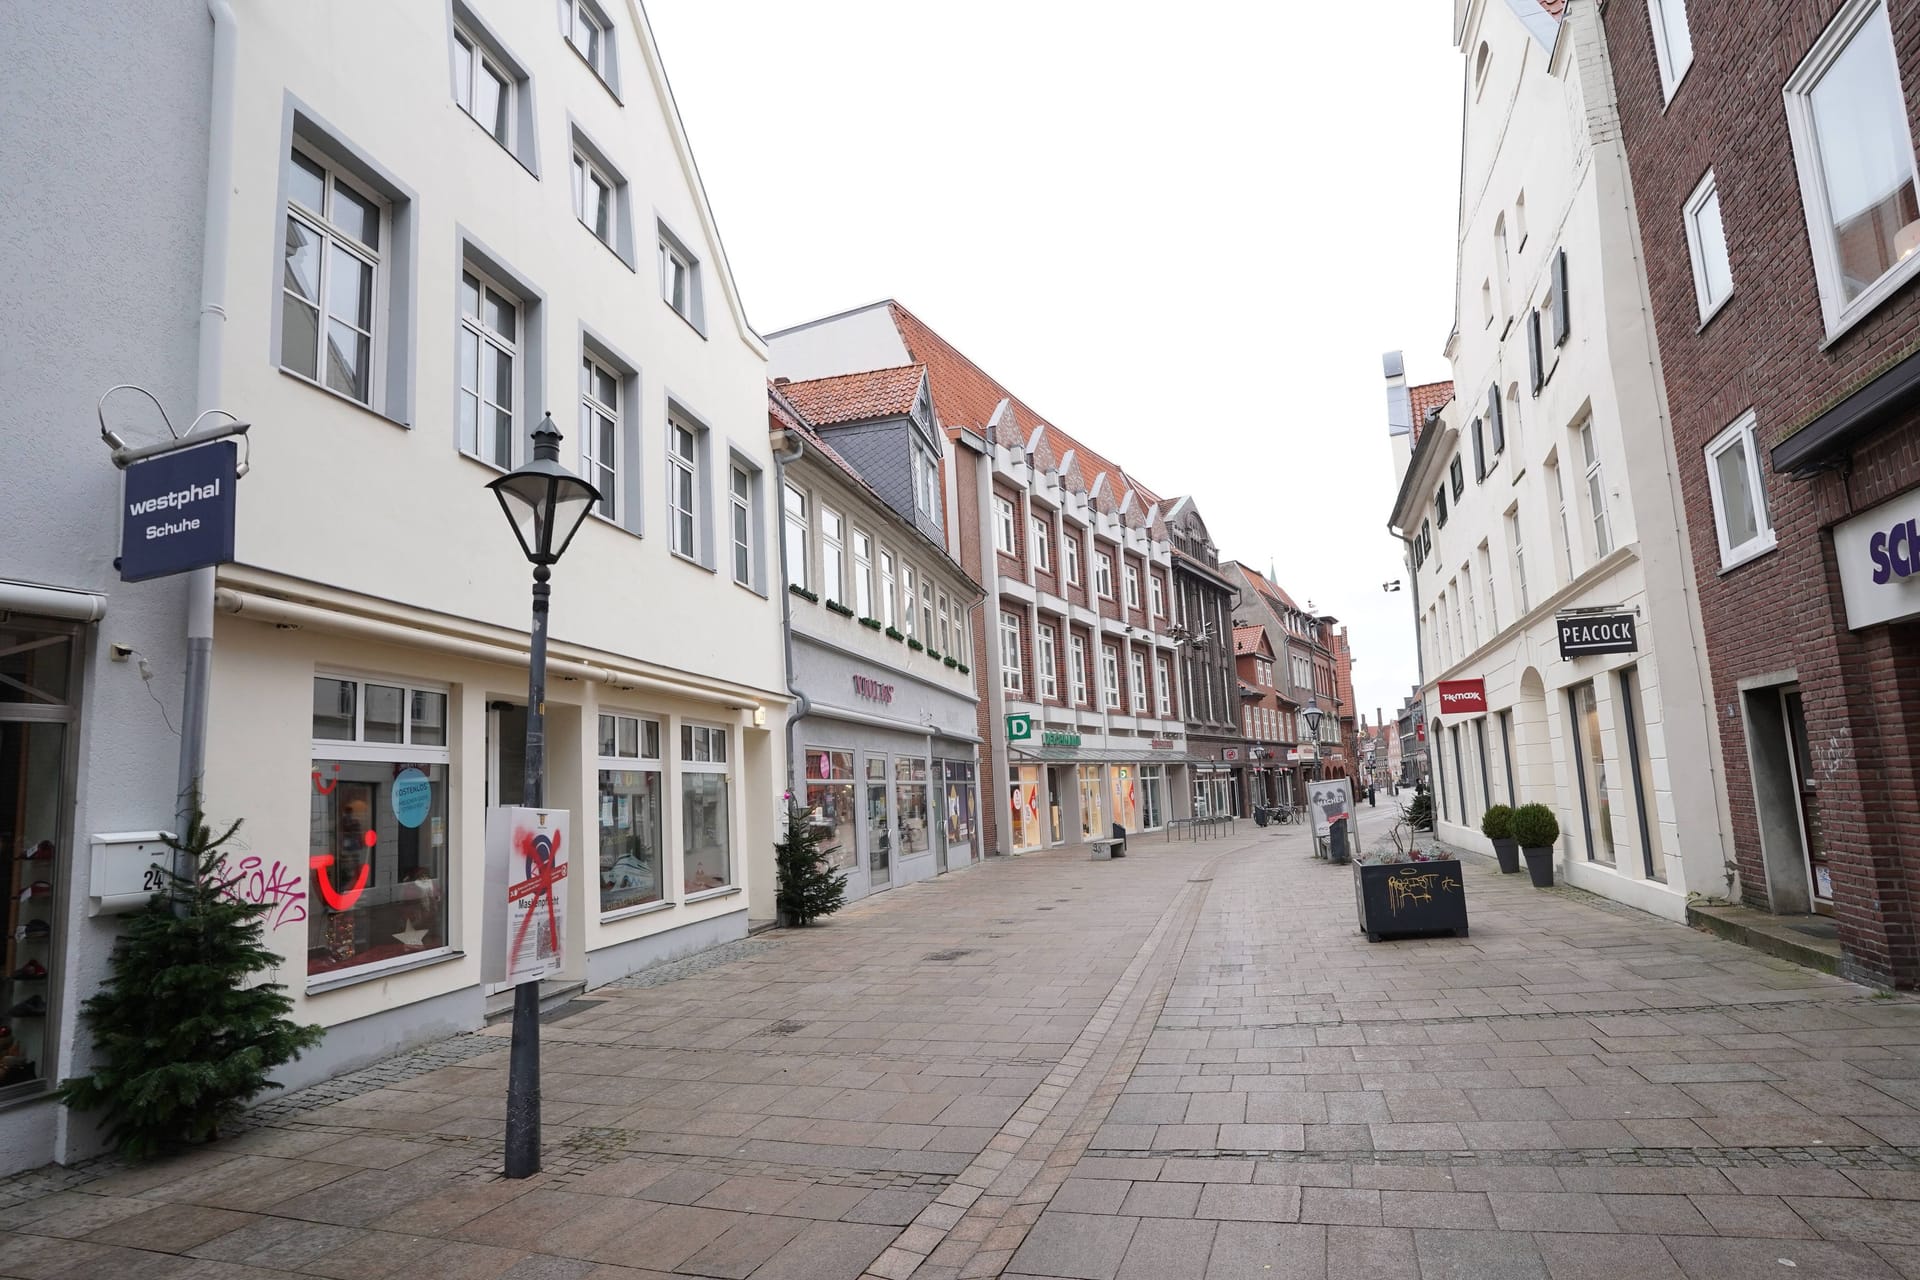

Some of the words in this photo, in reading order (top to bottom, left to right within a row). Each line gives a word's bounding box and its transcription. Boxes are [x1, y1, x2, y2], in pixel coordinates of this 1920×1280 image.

[130, 478, 220, 516] westphal
[145, 518, 201, 540] Schuhe
[1562, 623, 1631, 643] PEACOCK
[1011, 719, 1028, 736] D
[143, 870, 163, 891] 24
